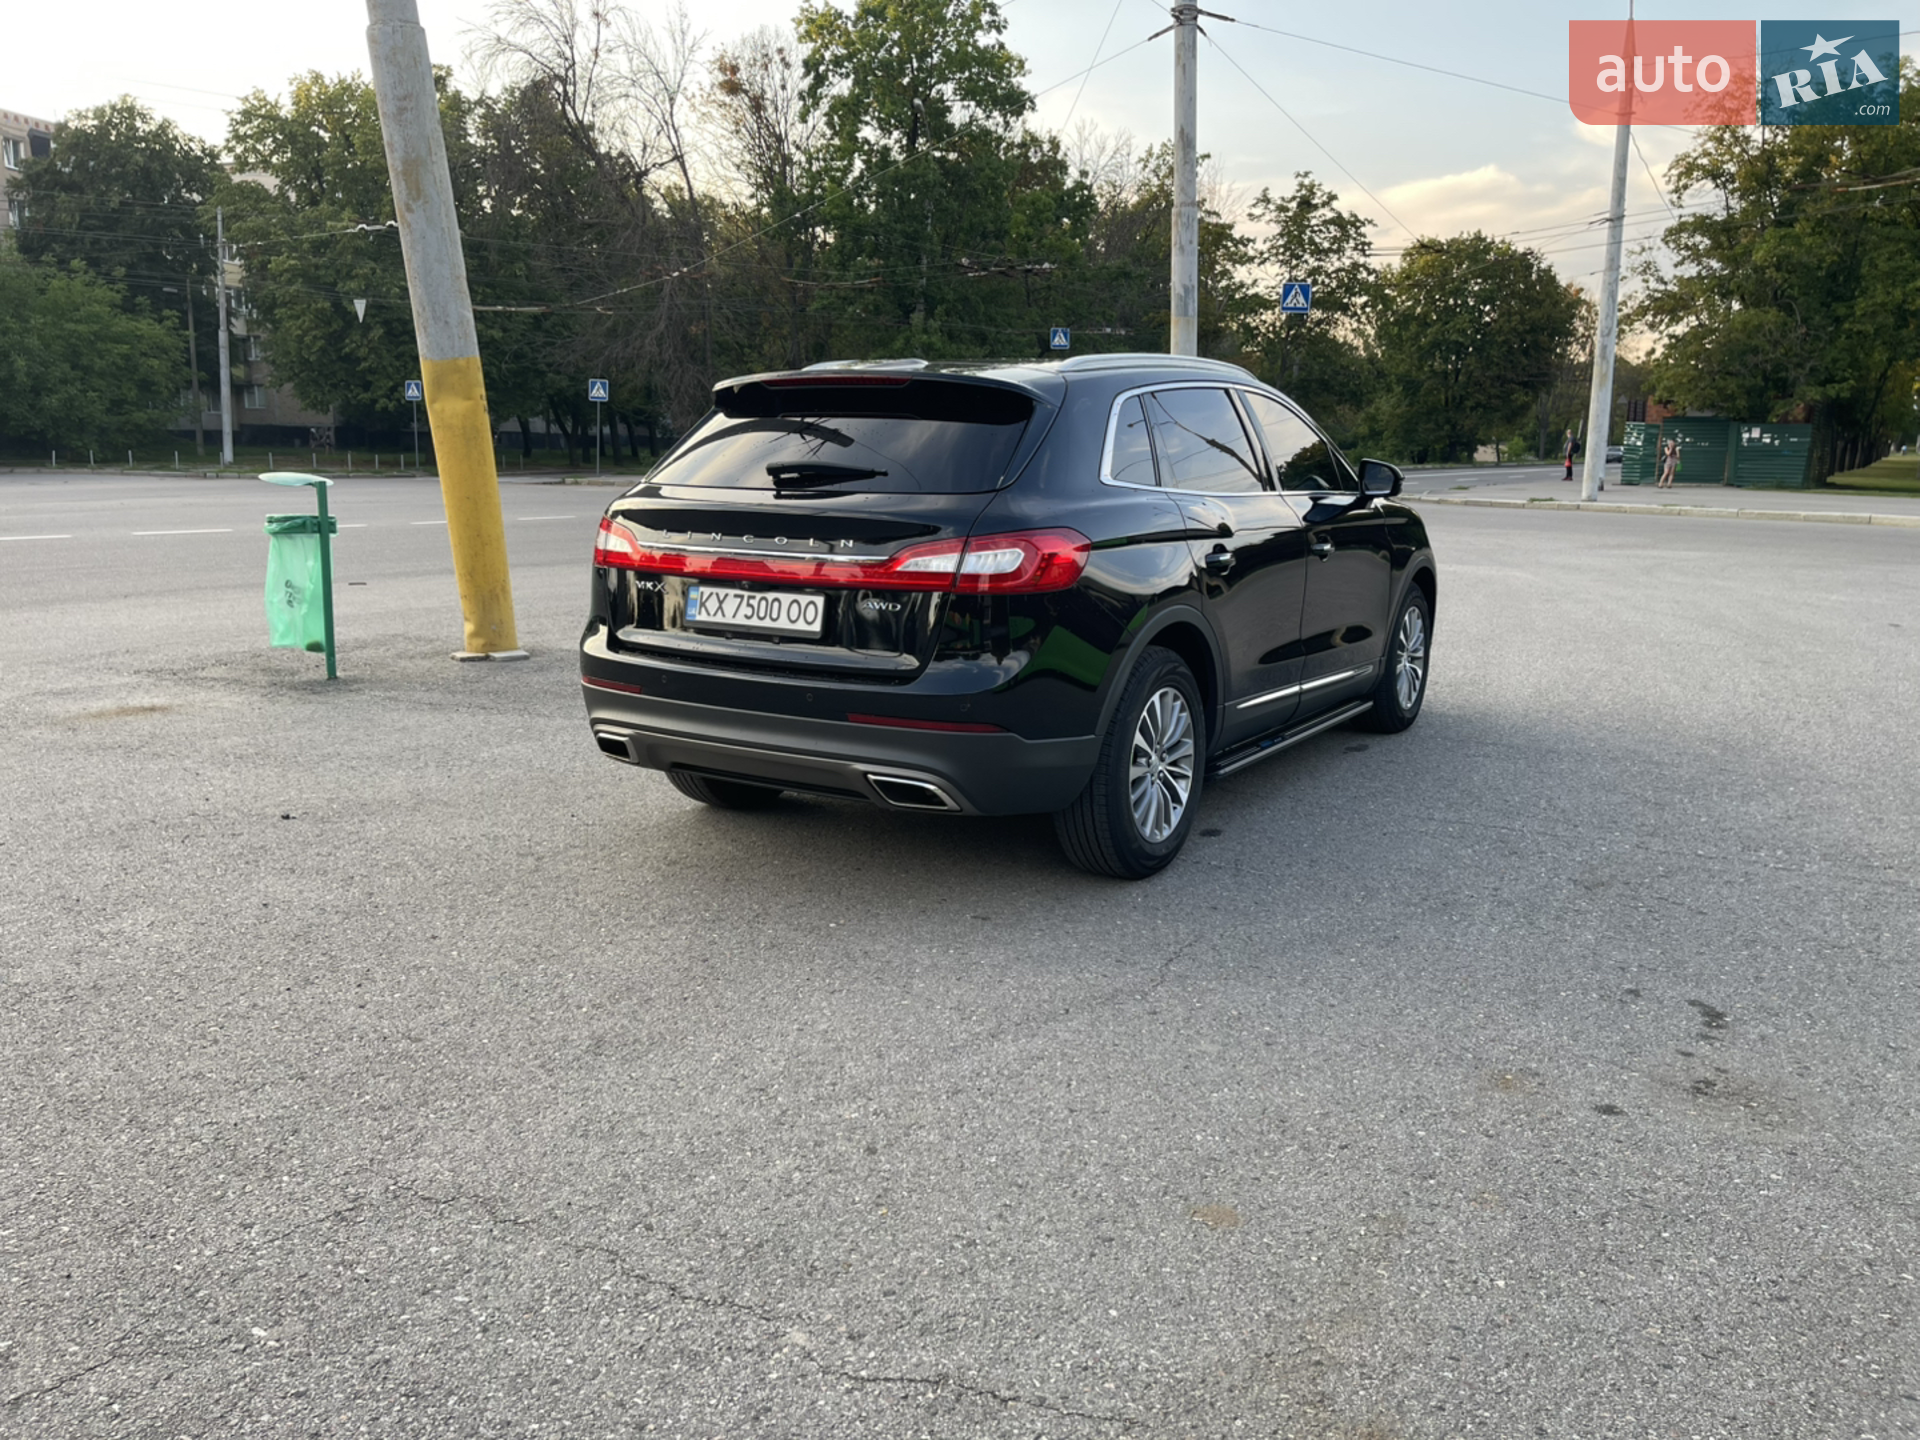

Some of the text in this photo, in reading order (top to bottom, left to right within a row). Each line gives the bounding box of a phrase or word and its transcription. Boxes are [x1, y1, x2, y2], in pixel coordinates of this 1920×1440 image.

[662, 529, 854, 549] LINCOLN
[635, 580, 667, 594] MKX
[698, 591, 729, 618] KX
[732, 593, 783, 623] 7500
[862, 601, 901, 612] AWD
